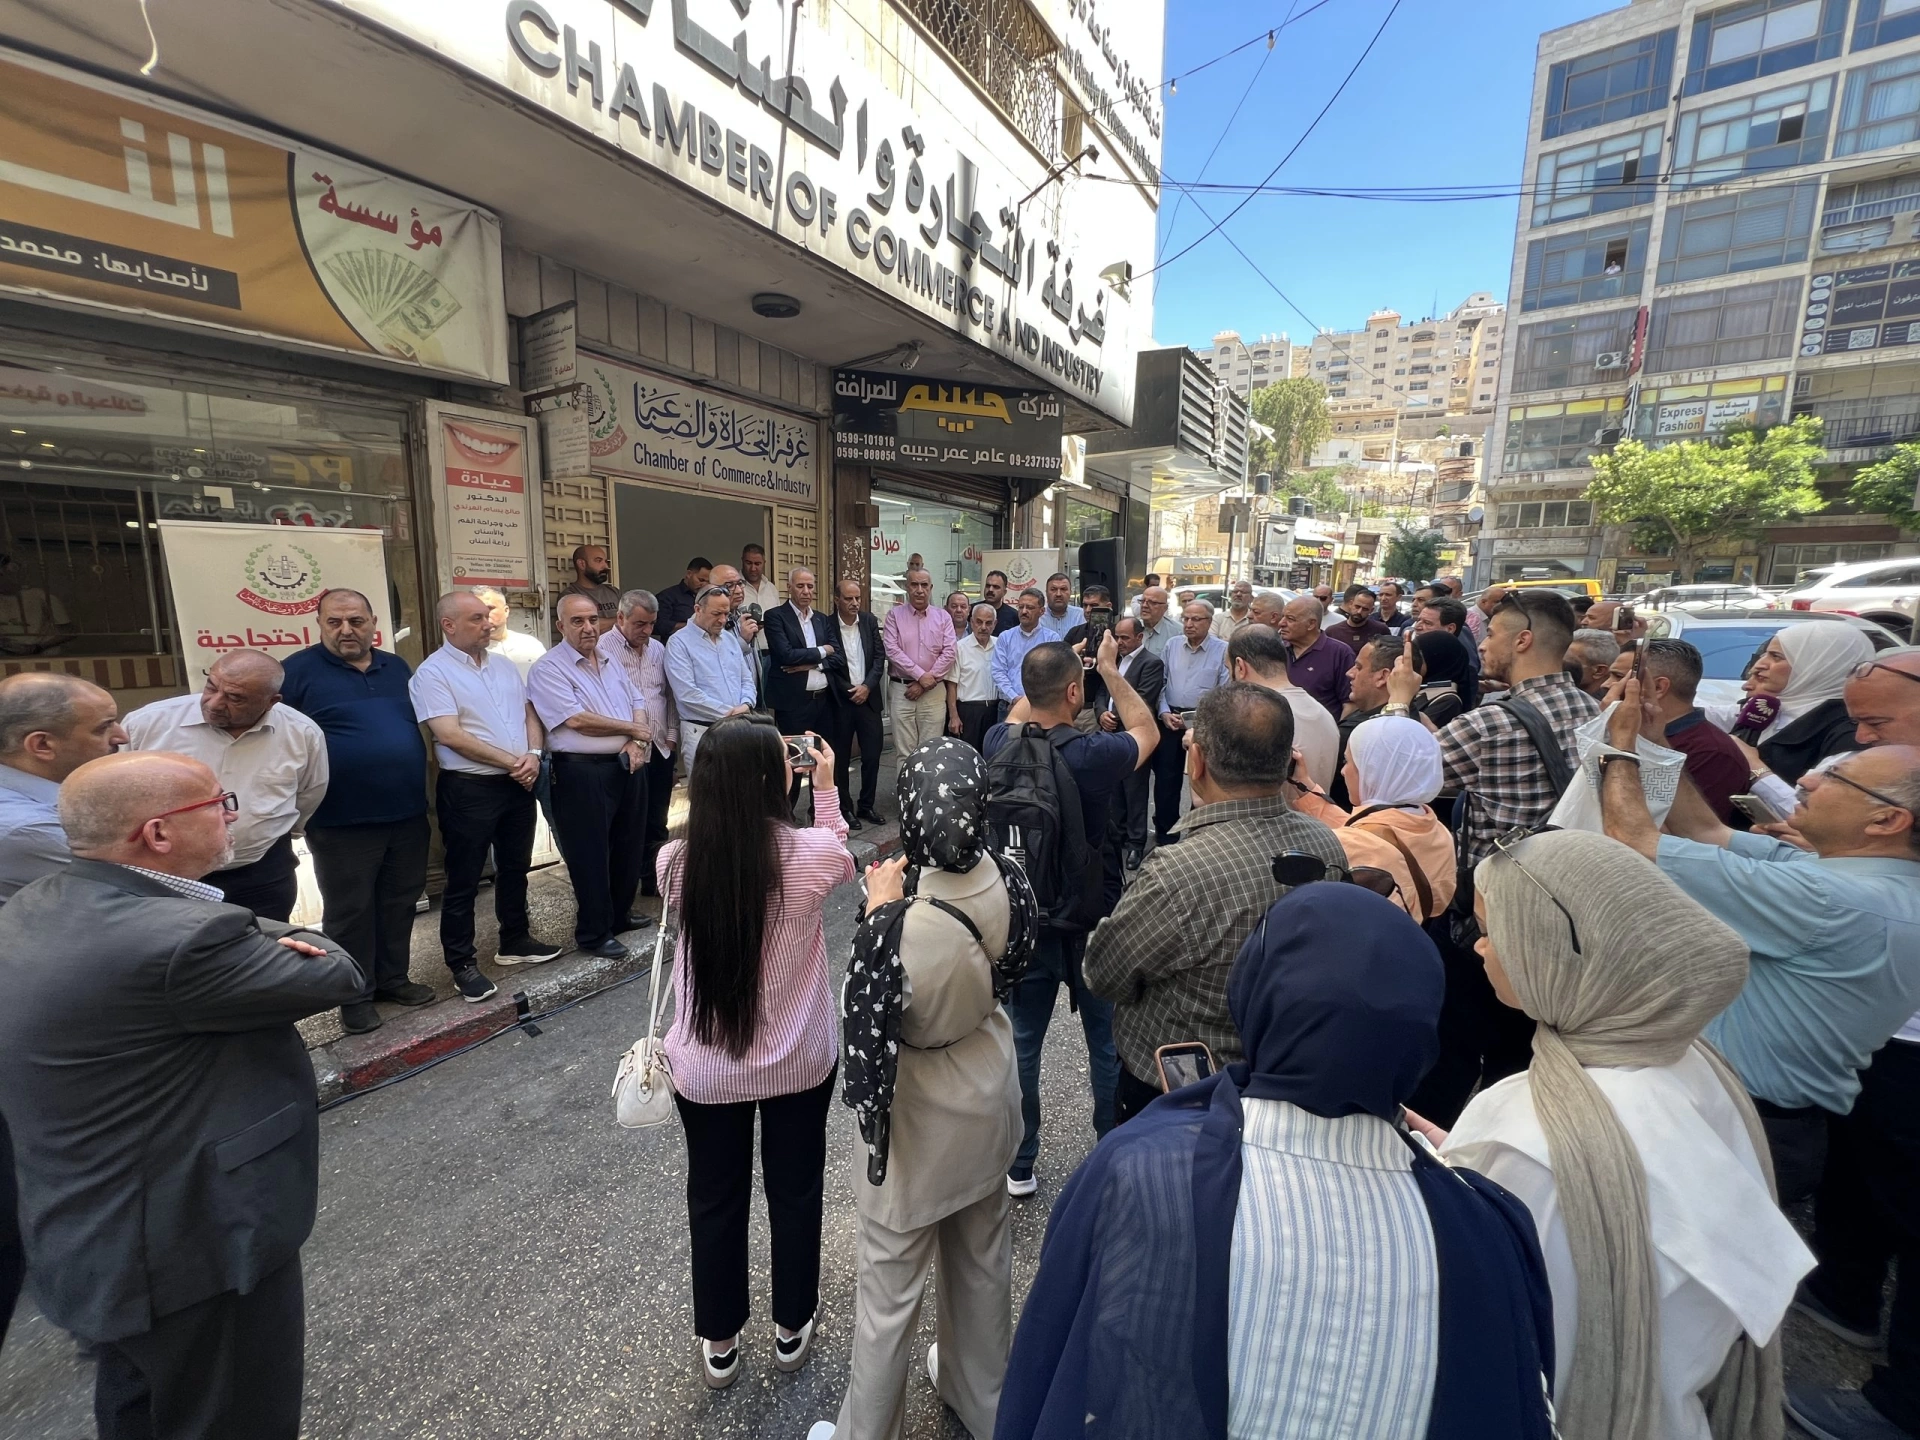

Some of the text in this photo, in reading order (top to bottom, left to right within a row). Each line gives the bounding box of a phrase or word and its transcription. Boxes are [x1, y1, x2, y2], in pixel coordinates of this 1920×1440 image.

[506, 0, 1104, 396] CHAMBER OF COMMERCE AND INDUSTRY
[311, 171, 443, 251] مؤسسة
[901, 125, 1035, 295] التجارة
[0, 235, 83, 265] محمد
[1042, 240, 1105, 347] غرفة
[835, 374, 897, 404] للصرافة
[1018, 393, 1059, 421] شركة
[1660, 404, 1704, 419] Express
[1658, 420, 1700, 432] Fashion
[836, 431, 895, 447] 0599-101916
[633, 442, 689, 473] Chamber
[694, 456, 708, 476] of
[836, 447, 896, 462] 0599-888854
[940, 449, 969, 463] عمر
[972, 448, 1005, 464] عامر
[1009, 453, 1061, 469] 09-2371357
[461, 471, 511, 489] عيادة
[466, 493, 508, 503] الدكتور
[477, 519, 503, 528] وجراحة
[197, 626, 310, 653] إحتجاجية
